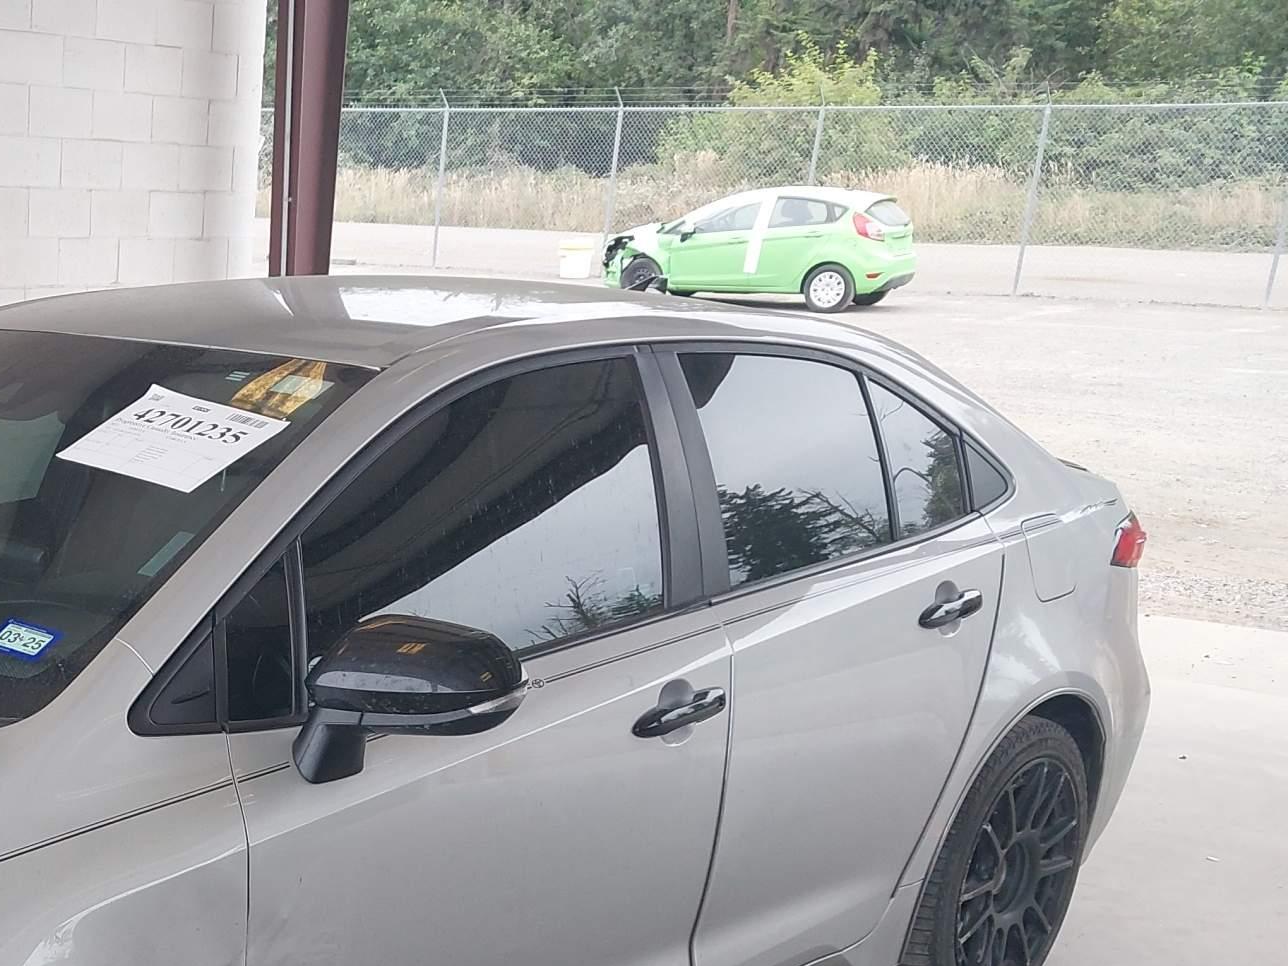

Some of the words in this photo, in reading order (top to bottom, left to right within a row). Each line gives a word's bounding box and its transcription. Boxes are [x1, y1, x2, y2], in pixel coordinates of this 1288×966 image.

[133, 407, 249, 444] 42701235
[0, 630, 22, 643] 03
[21, 636, 46, 650] 25
